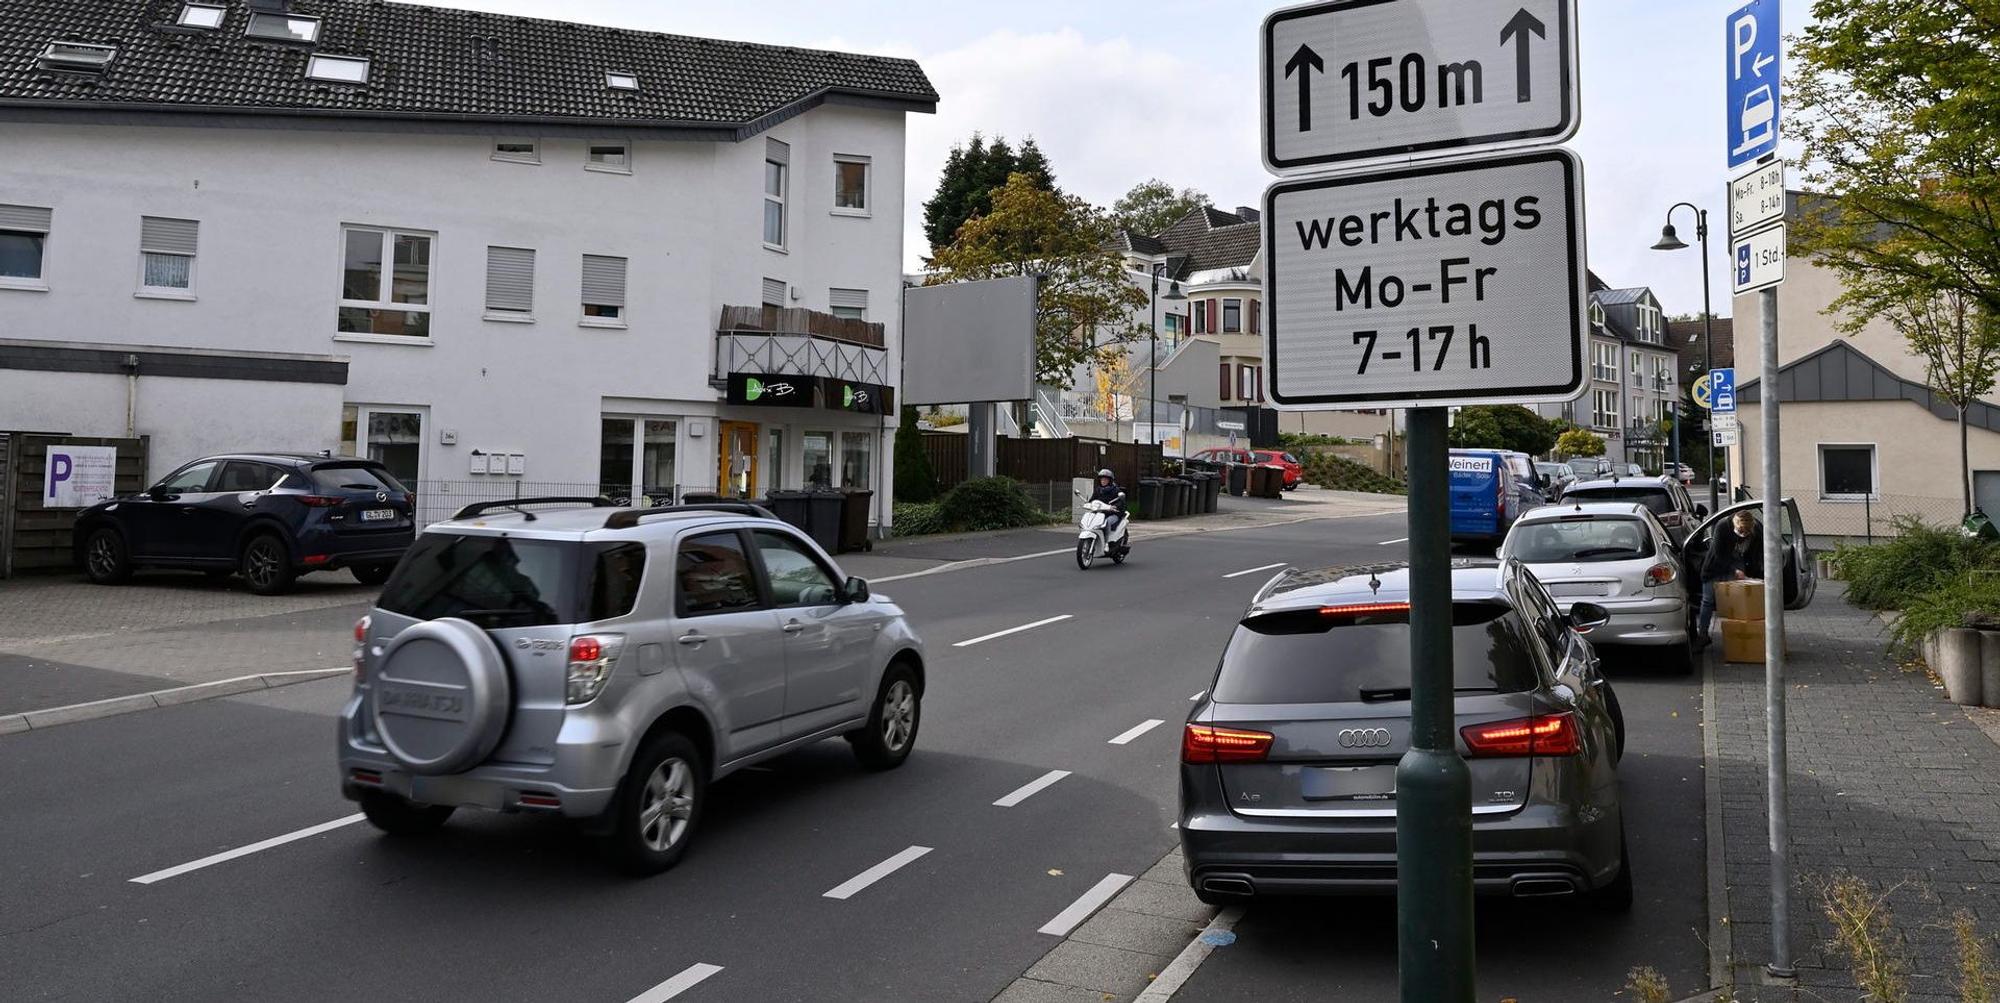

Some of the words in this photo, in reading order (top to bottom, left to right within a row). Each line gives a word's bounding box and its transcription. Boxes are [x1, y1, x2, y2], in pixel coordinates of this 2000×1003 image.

[1734, 14, 1757, 80] P
[1341, 52, 1426, 120] 150
[1438, 59, 1483, 109] m
[1296, 195, 1542, 250] werktags
[1762, 246, 1780, 267] Std.
[1335, 257, 1498, 312] Mo-Fr
[1353, 325, 1455, 375] 7-17
[1469, 324, 1491, 370] h
[1713, 372, 1724, 389] P
[49, 454, 72, 498] P
